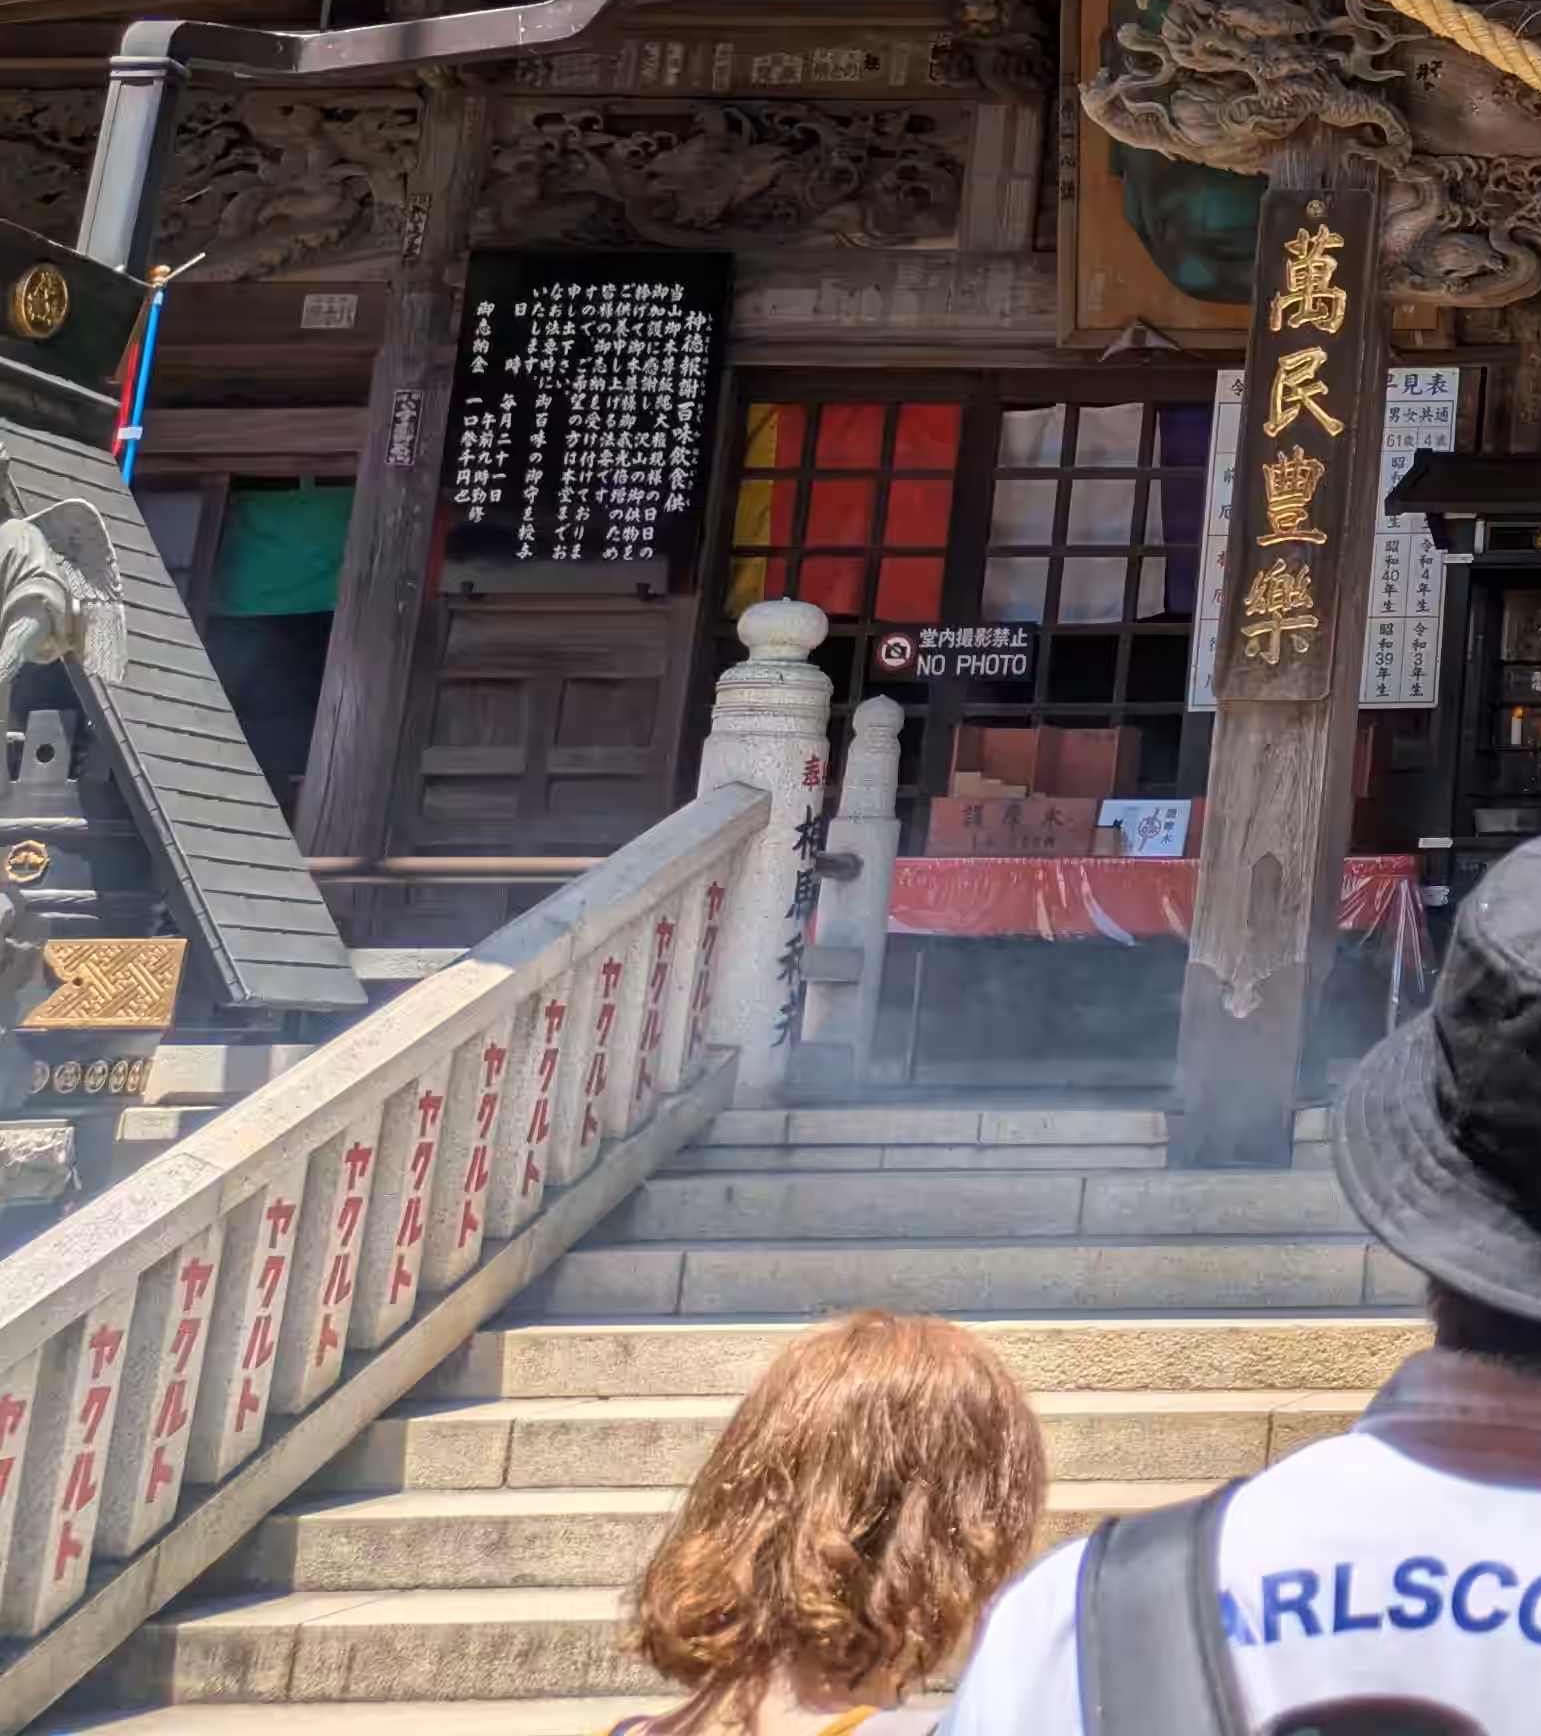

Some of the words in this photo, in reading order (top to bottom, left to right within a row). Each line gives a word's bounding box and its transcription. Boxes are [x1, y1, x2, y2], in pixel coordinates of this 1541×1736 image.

[1388, 406, 1449, 424] 男女共通
[916, 654, 946, 677] NO
[955, 653, 1028, 676] PHOTO
[918, 627, 1028, 649] 堂内撮影禁止
[1375, 622, 1395, 698] 昭和39年生
[1380, 539, 1401, 613] 昭和40年生
[1409, 621, 1431, 698] 令和3年生
[1415, 538, 1437, 613] 令和4年生
[581, 957, 622, 1146] ヤクルト
[636, 916, 675, 1100] ヤクルト
[687, 881, 726, 1059] ヤクルト
[458, 1043, 507, 1249] ヤクルト
[522, 1000, 568, 1197] ヤクルト
[315, 1142, 373, 1368] ヤクルト
[389, 1090, 442, 1305] ヤクルト
[145, 1257, 214, 1505] ヤクルト
[236, 1198, 295, 1433] ヤクルト
[54, 1322, 125, 1582] ヤクルト
